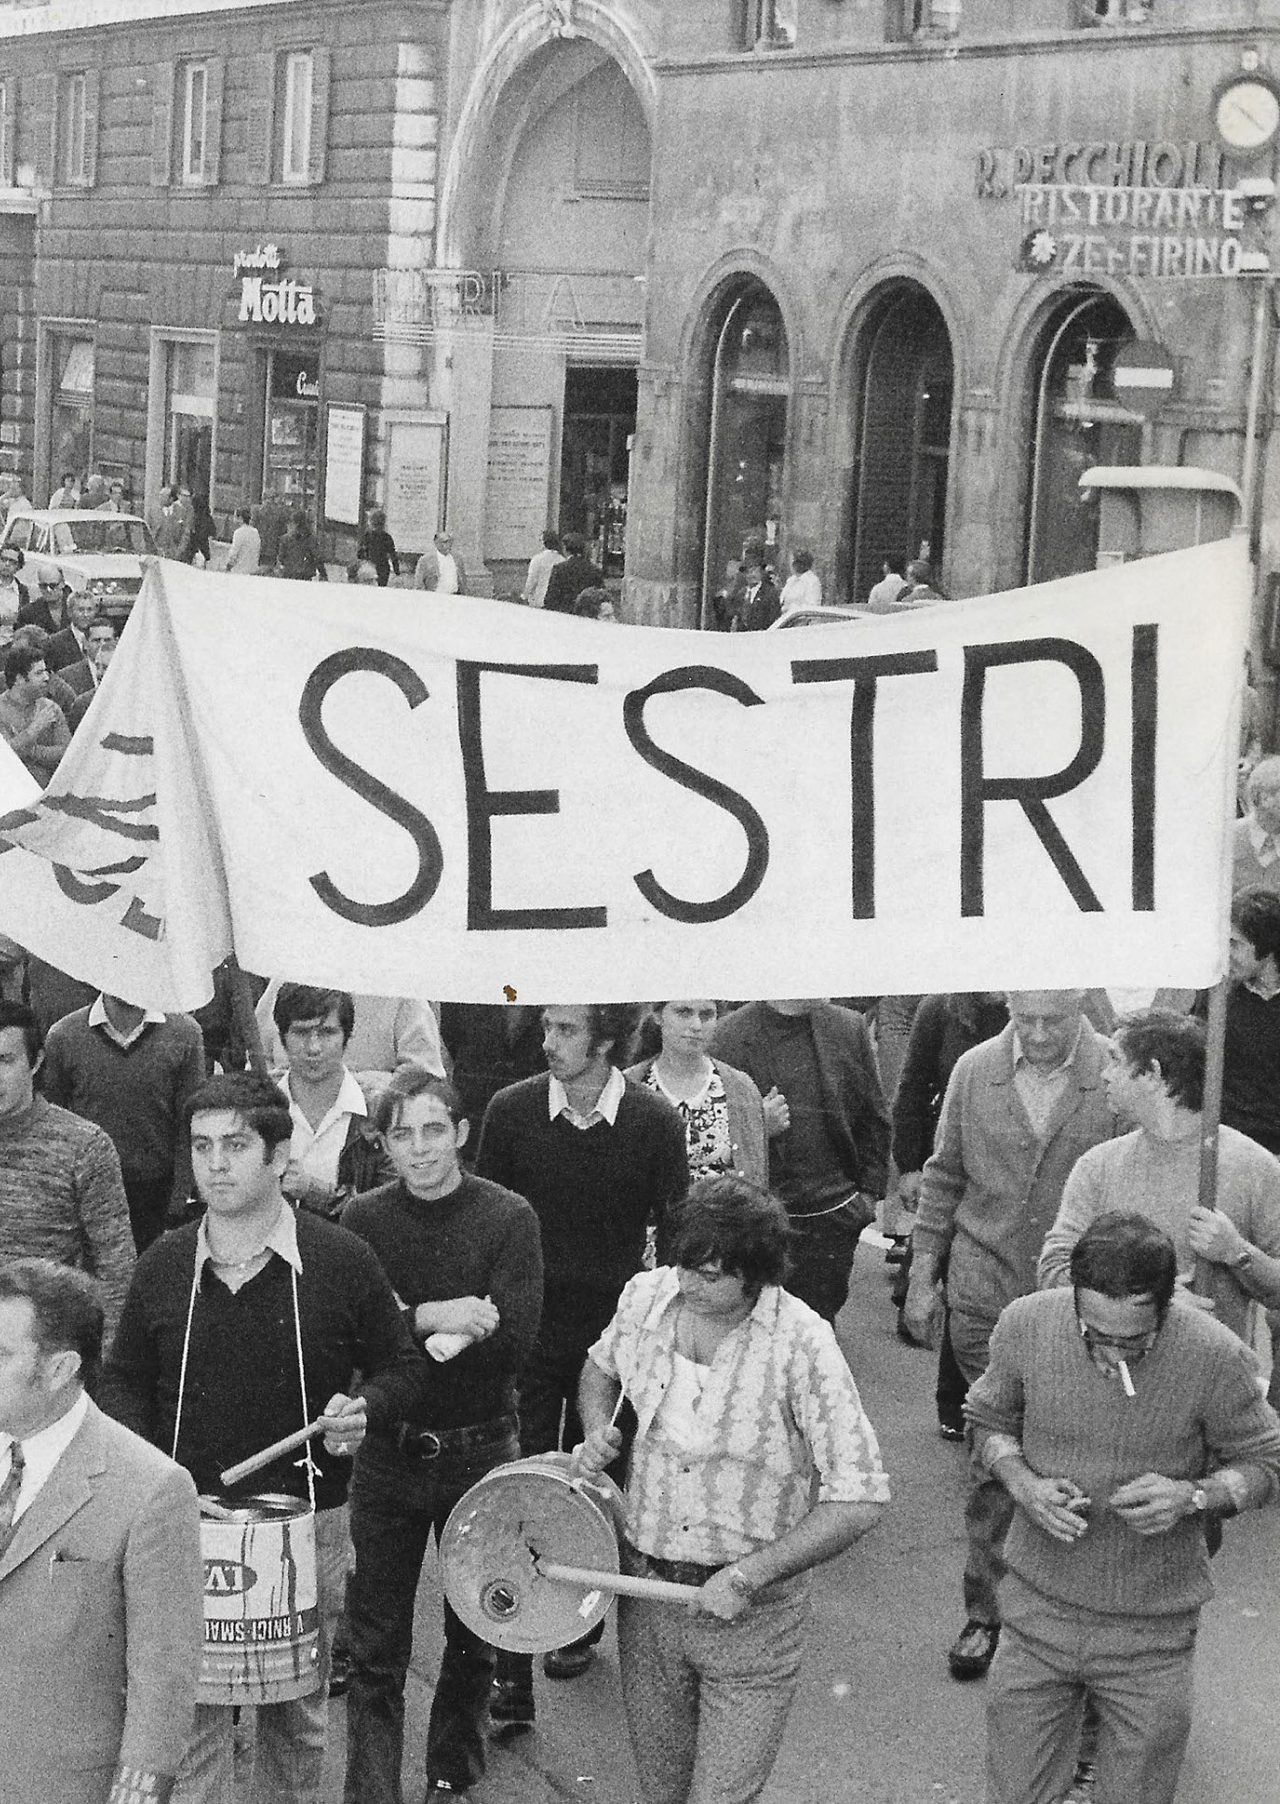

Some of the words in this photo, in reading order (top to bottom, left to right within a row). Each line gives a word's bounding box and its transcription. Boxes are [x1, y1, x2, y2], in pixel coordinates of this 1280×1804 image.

[1022, 187, 1245, 230] RISTORANTE
[238, 277, 316, 325] Motta
[299, 623, 1158, 931] SESTRI
[204, 1621, 245, 1641] SMAL
[252, 1614, 304, 1640] VRNICI
